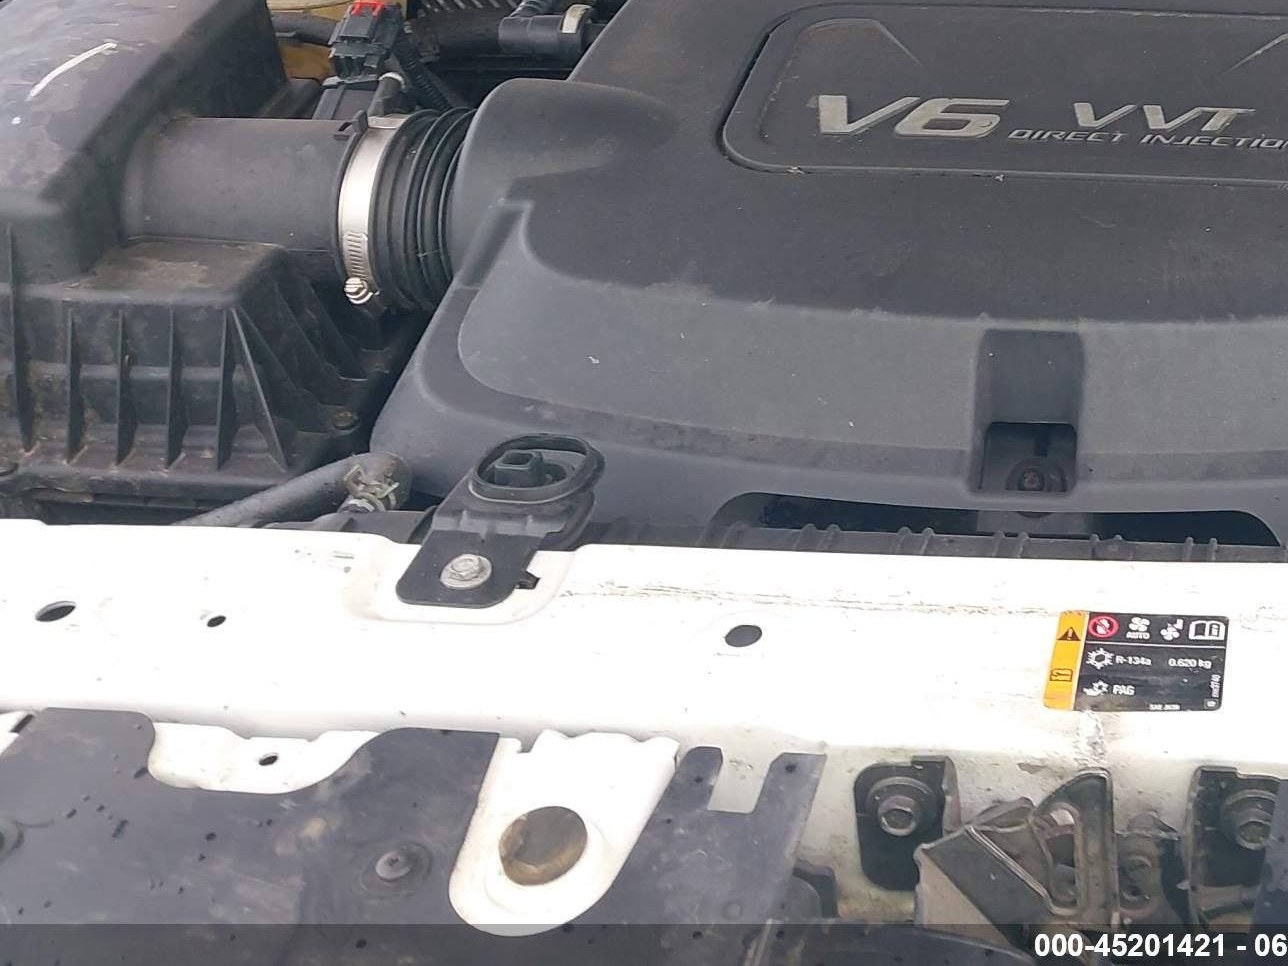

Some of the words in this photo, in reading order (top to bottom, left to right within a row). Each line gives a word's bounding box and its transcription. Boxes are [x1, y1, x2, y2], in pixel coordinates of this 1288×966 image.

[818, 95, 1010, 138] V6
[1072, 102, 1256, 132] VVT
[1007, 129, 1125, 143] DIRECT
[1125, 631, 1151, 640] AUTO
[1115, 655, 1152, 666] R-134a
[1168, 658, 1198, 668] 0.620
[1198, 659, 1212, 669] kg
[1112, 684, 1136, 696] PAG
